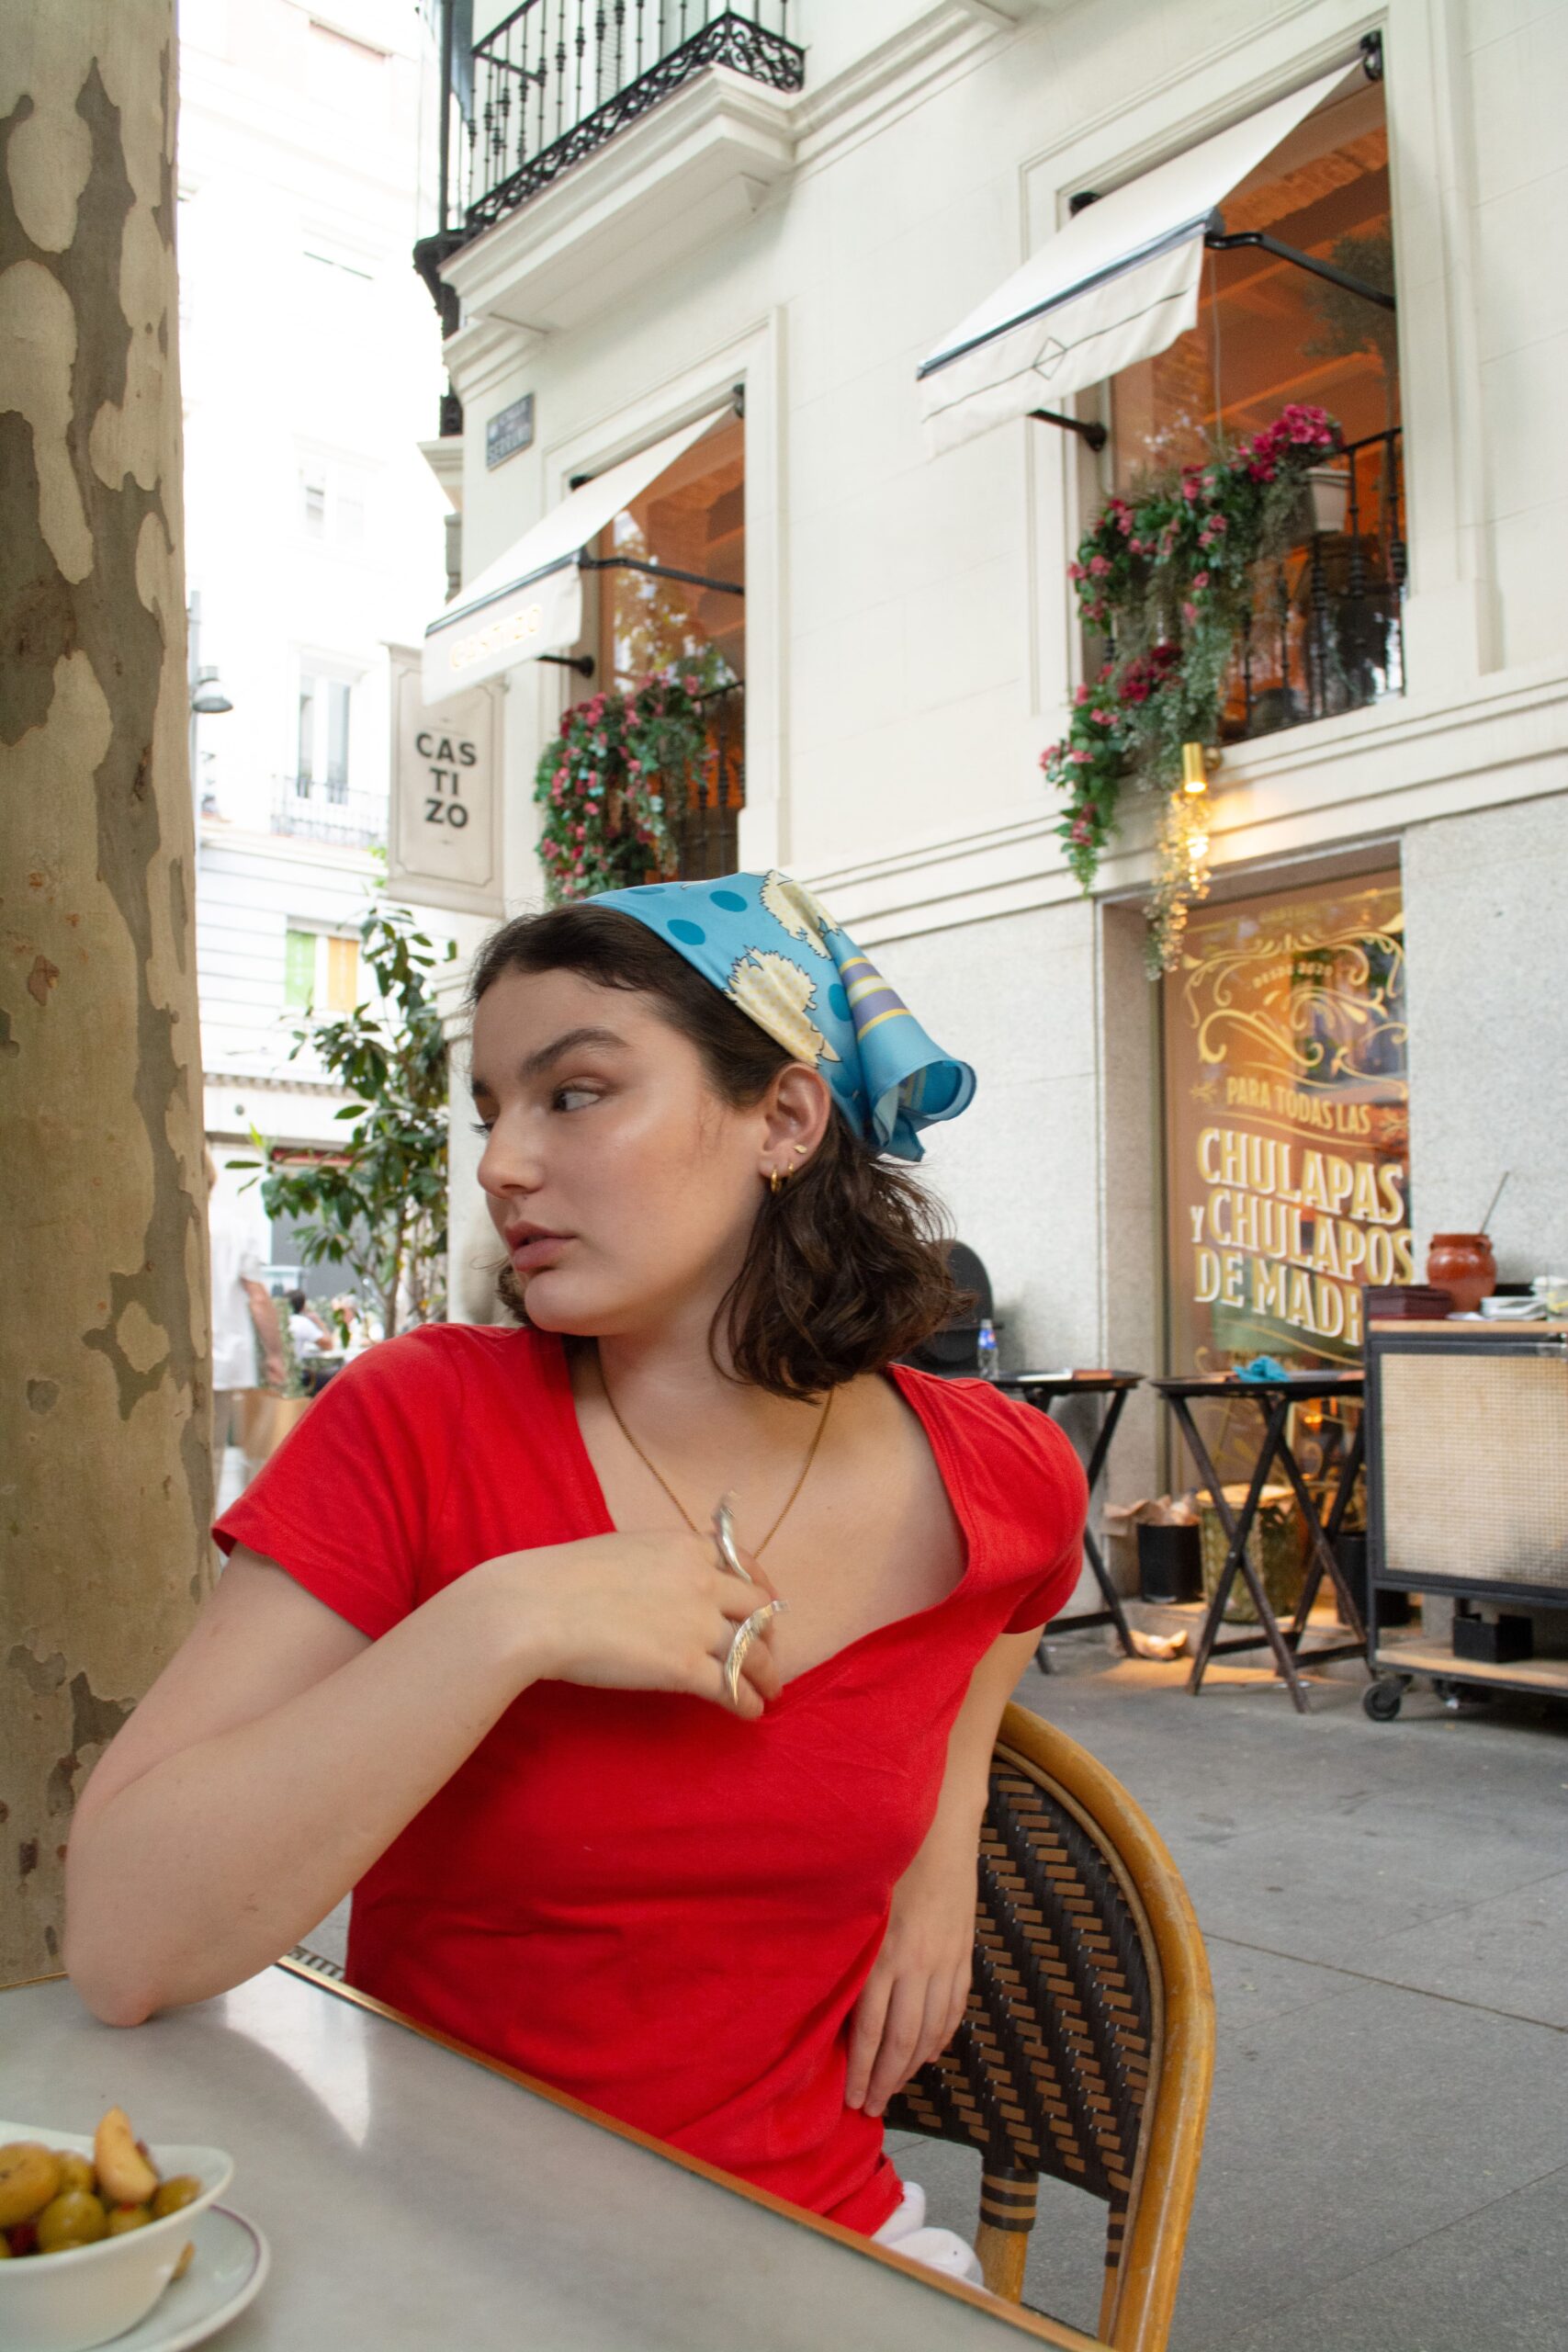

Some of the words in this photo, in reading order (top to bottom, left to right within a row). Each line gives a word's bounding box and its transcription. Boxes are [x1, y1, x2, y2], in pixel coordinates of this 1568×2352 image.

[416, 732, 477, 766] CAS
[430, 767, 459, 796] TI
[425, 798, 468, 829] ZO
[1226, 1077, 1271, 1110] PARA
[1275, 1085, 1334, 1130] TODAS
[1337, 1103, 1371, 1135] LAS
[1197, 1126, 1405, 1226] CHULAPAS
[1190, 1204, 1205, 1243] Y
[1208, 1187, 1415, 1285] CHULAPOS
[1194, 1246, 1245, 1308] DE
